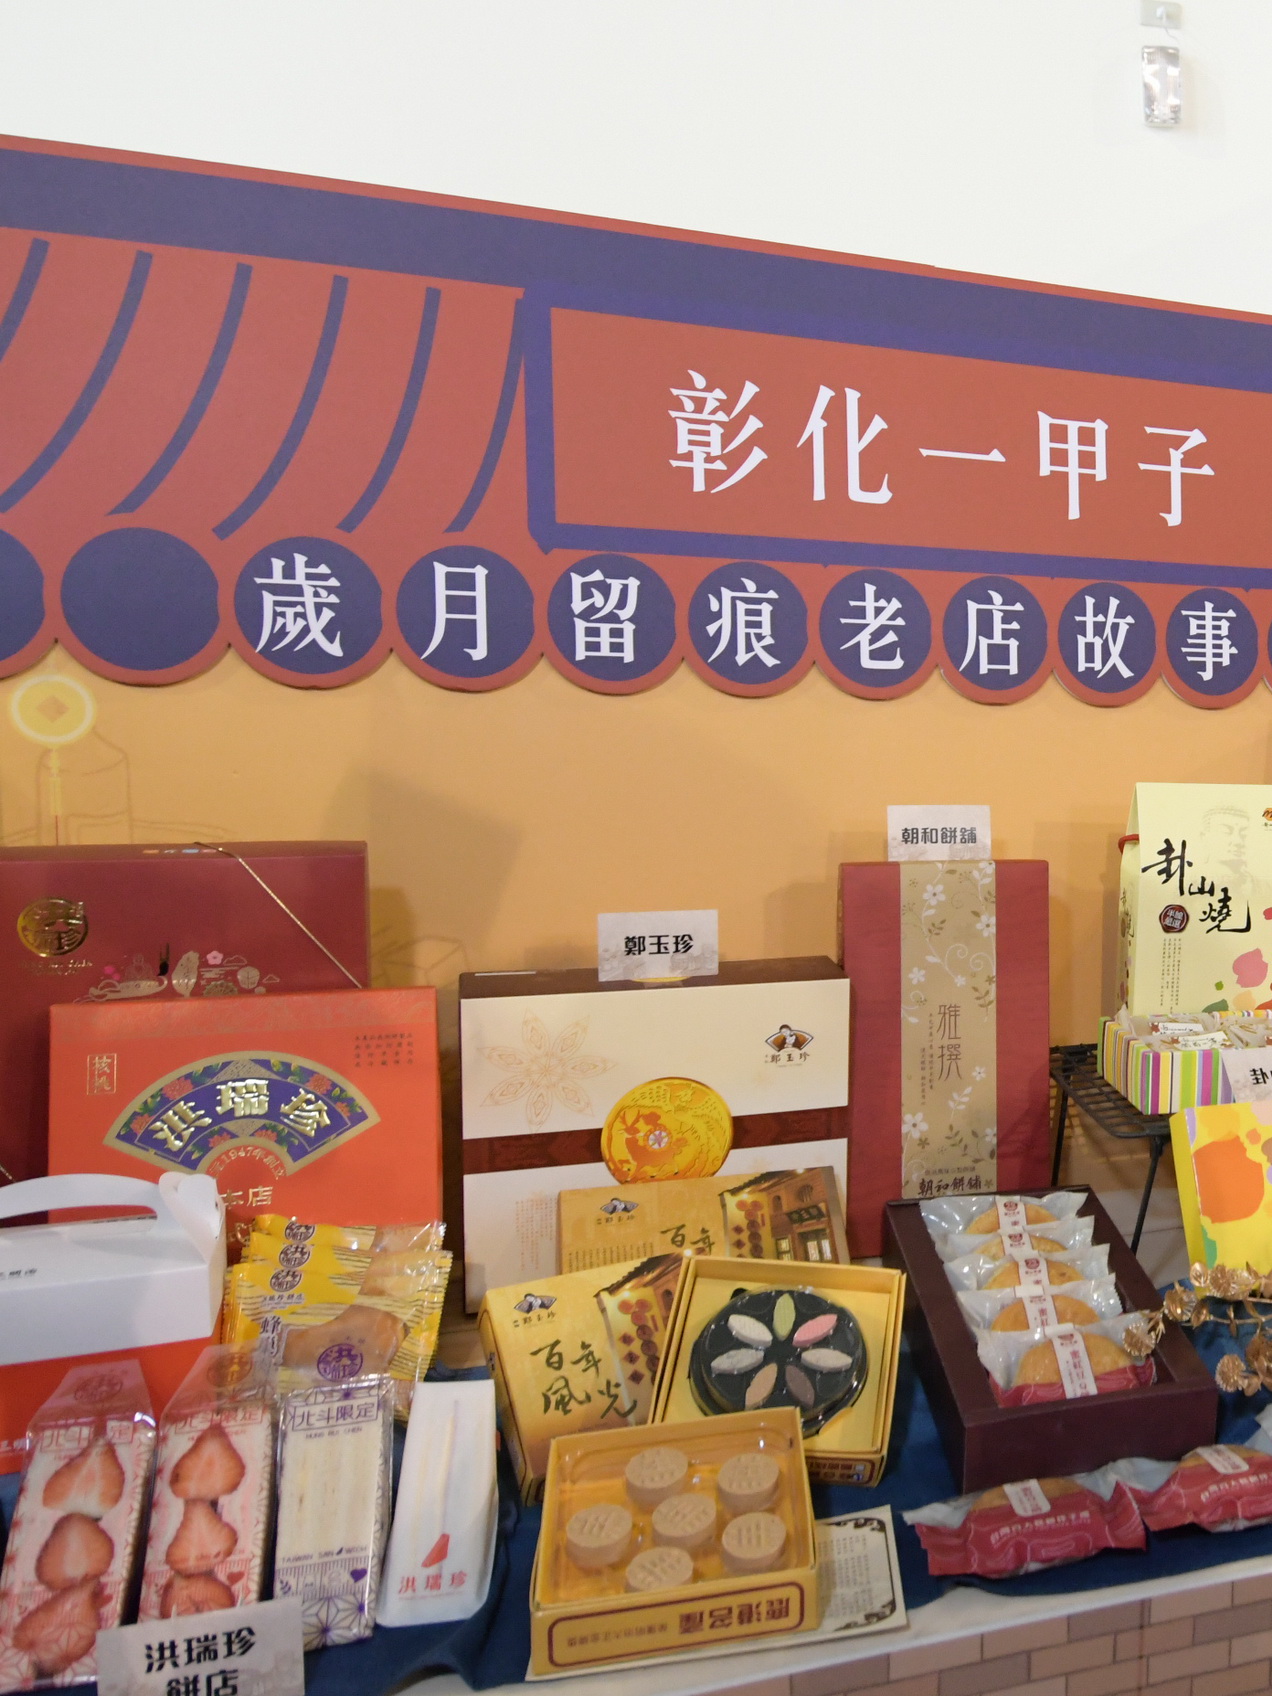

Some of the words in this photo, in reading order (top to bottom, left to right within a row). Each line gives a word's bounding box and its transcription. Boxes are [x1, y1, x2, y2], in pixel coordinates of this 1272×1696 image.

[668, 369, 1215, 527] 彰化一甲子
[901, 827, 977, 845] 朝和餅舖
[1141, 838, 1251, 933] 卦山燒
[624, 933, 694, 956] 鄭玉珍
[936, 1003, 962, 1081] 雅撰
[150, 1079, 331, 1151] 洪瑞珍
[530, 1339, 602, 1377] 百年
[298, 1402, 376, 1428] 北斗限定
[44, 1421, 130, 1448] 北斗定
[144, 1626, 256, 1673] 洪瑞珍
[166, 1669, 239, 1696] 餅店
